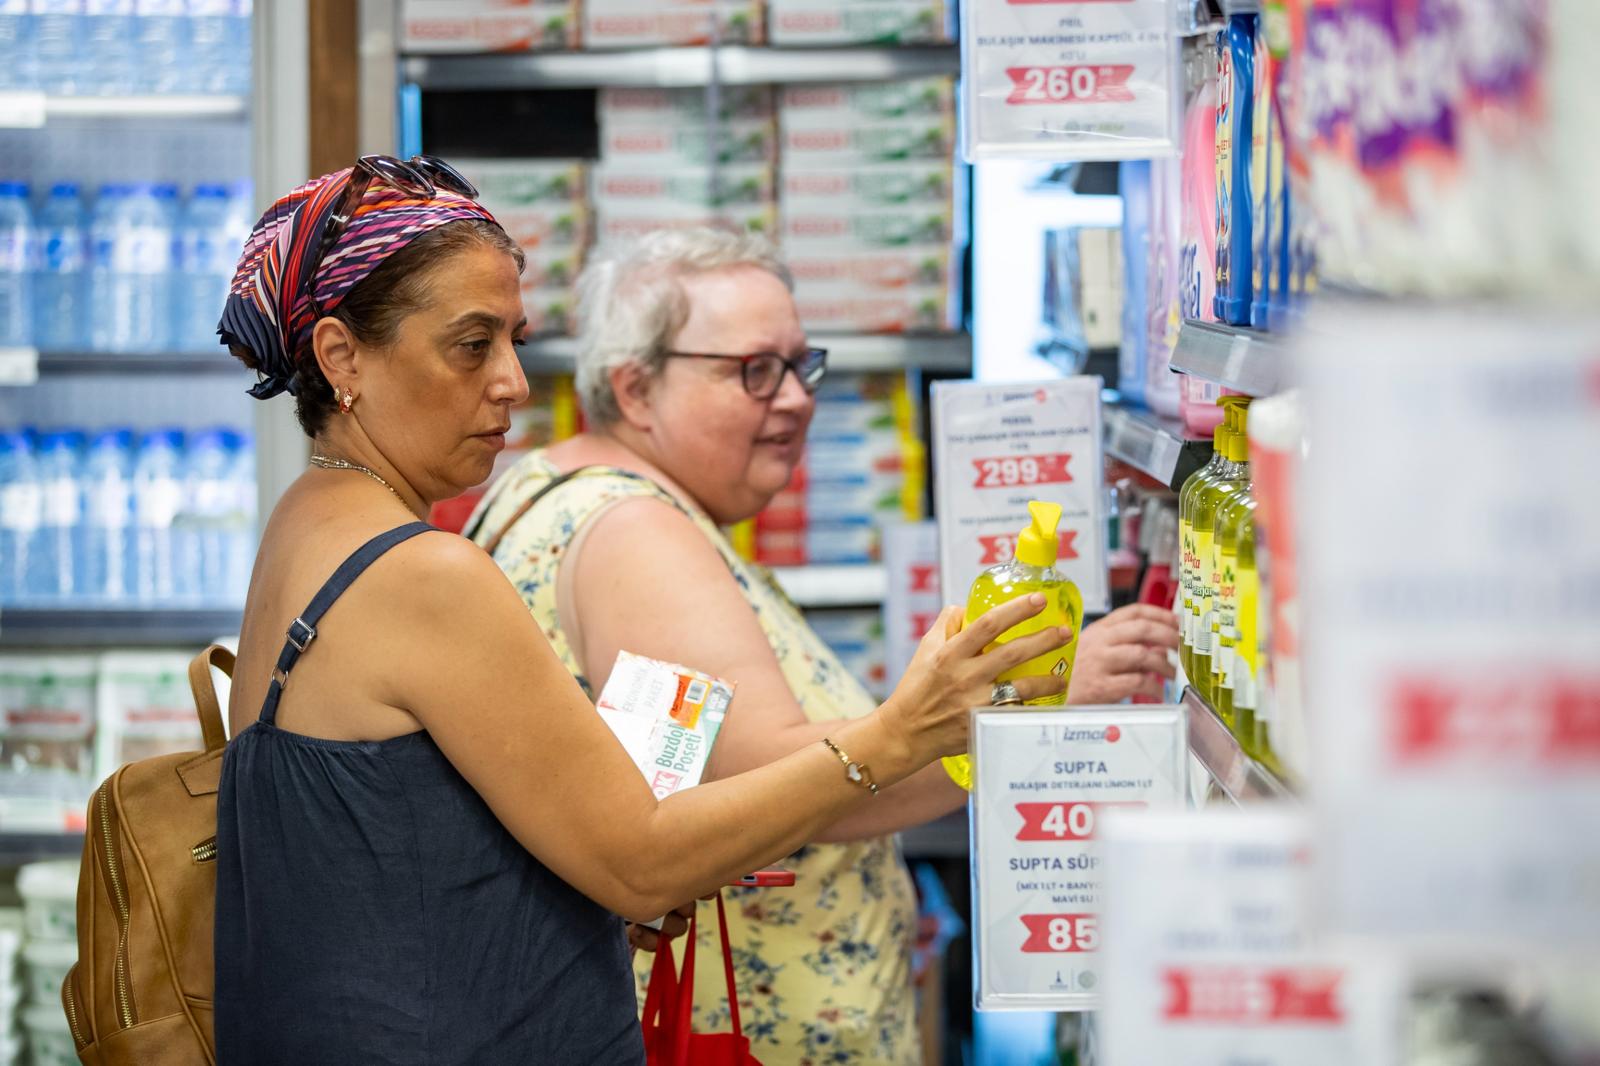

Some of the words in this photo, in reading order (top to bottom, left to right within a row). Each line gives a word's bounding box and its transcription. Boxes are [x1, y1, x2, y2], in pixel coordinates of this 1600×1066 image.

[1024, 67, 1096, 100] 260
[982, 458, 1039, 486] 299
[1054, 760, 1108, 774] SUPTA
[1040, 804, 1094, 838] 40
[1009, 857, 1063, 871] SUPTA
[1048, 917, 1099, 951] 85
